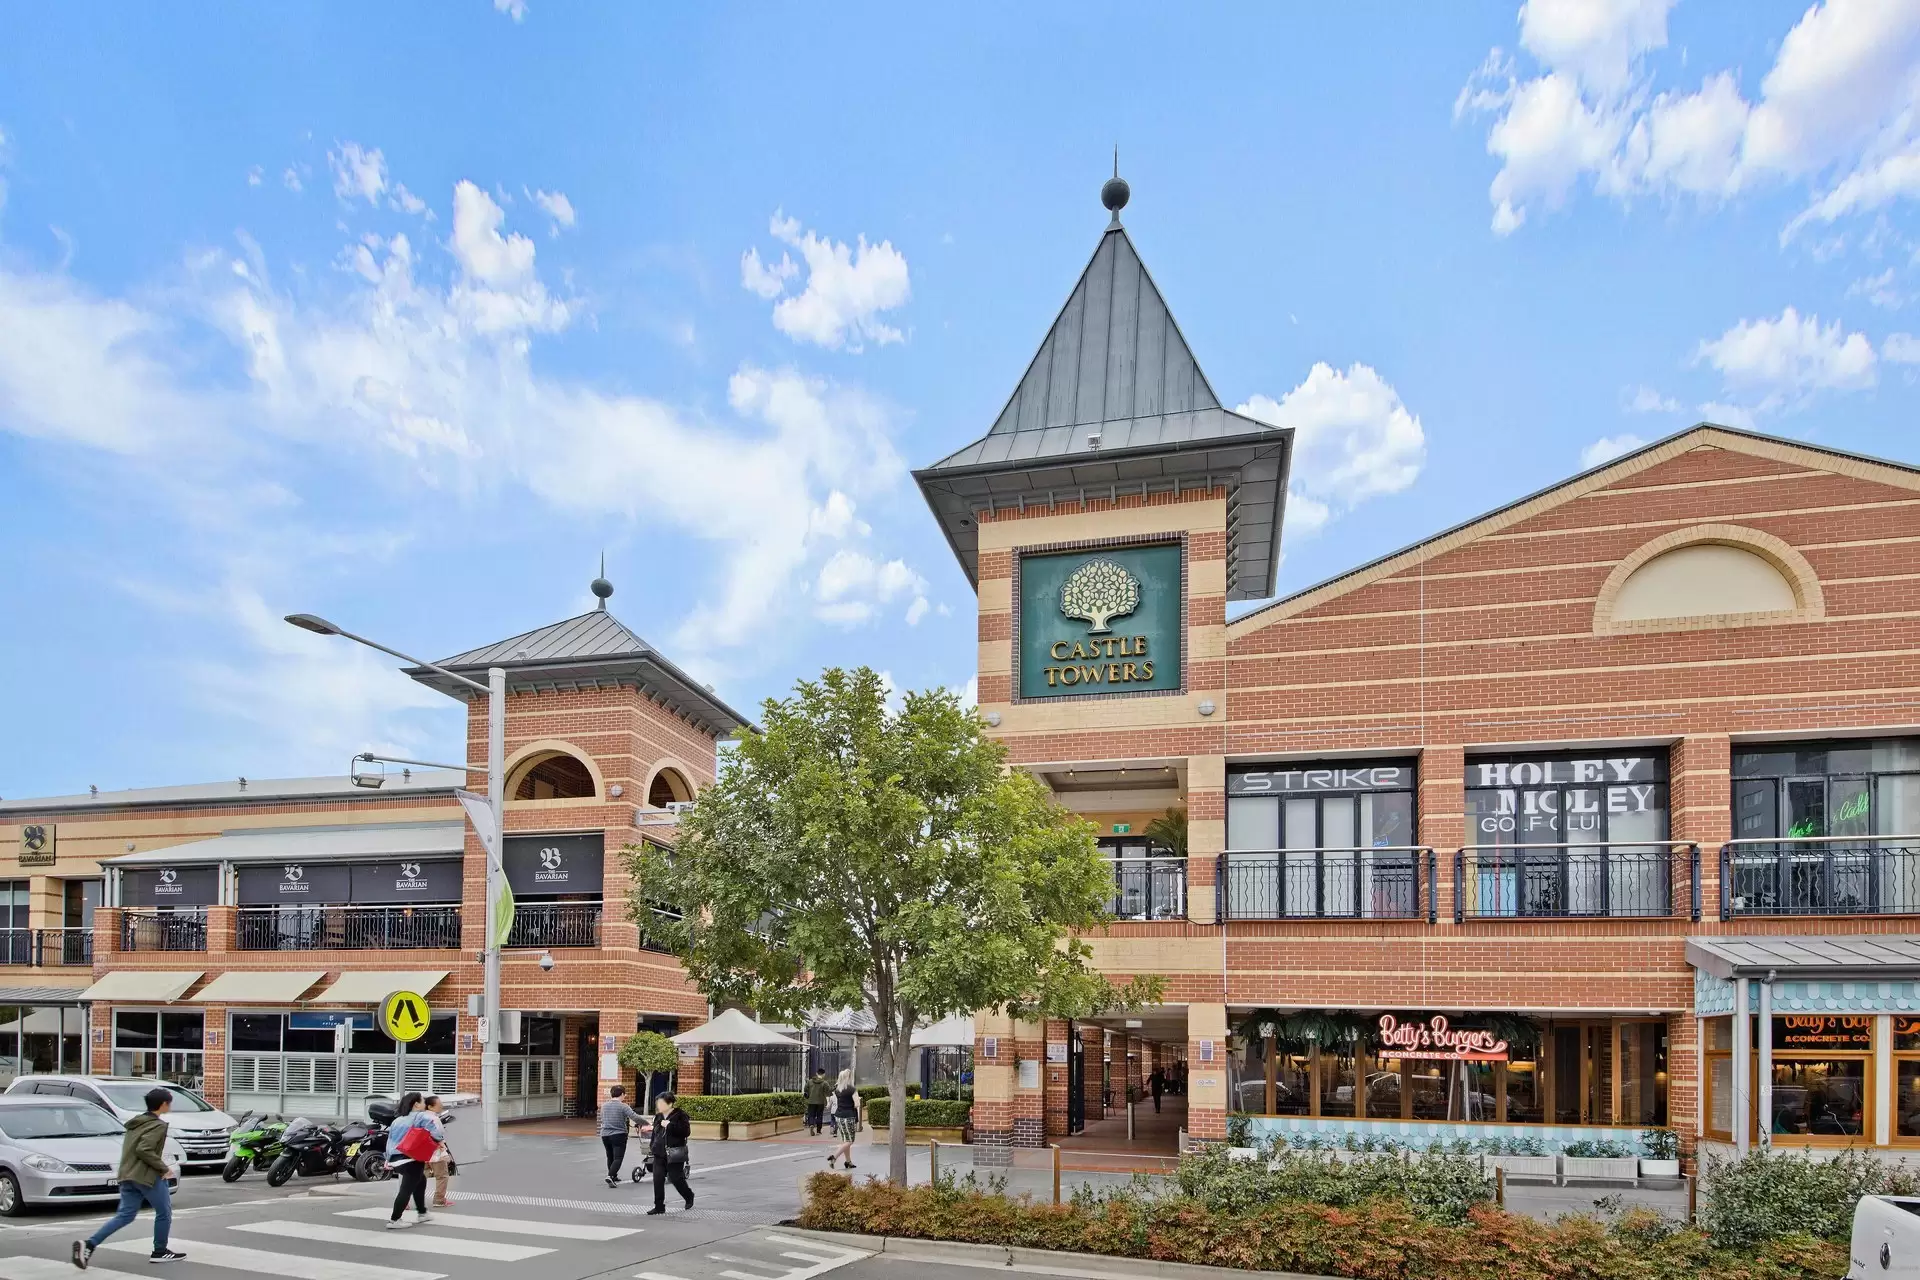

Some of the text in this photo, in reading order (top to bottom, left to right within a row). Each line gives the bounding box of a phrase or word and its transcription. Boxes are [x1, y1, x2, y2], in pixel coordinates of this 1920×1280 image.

[1050, 635, 1147, 661] CASTLE
[1044, 661, 1155, 687] TOWERS
[1243, 767, 1401, 791] STRIKE
[1478, 757, 1641, 787] HOLEY
[1497, 785, 1656, 816] MOLEY
[1481, 816, 1544, 833] GOF
[1379, 1014, 1508, 1055] Betty's Burgers
[1444, 1052, 1462, 1060] CO.
